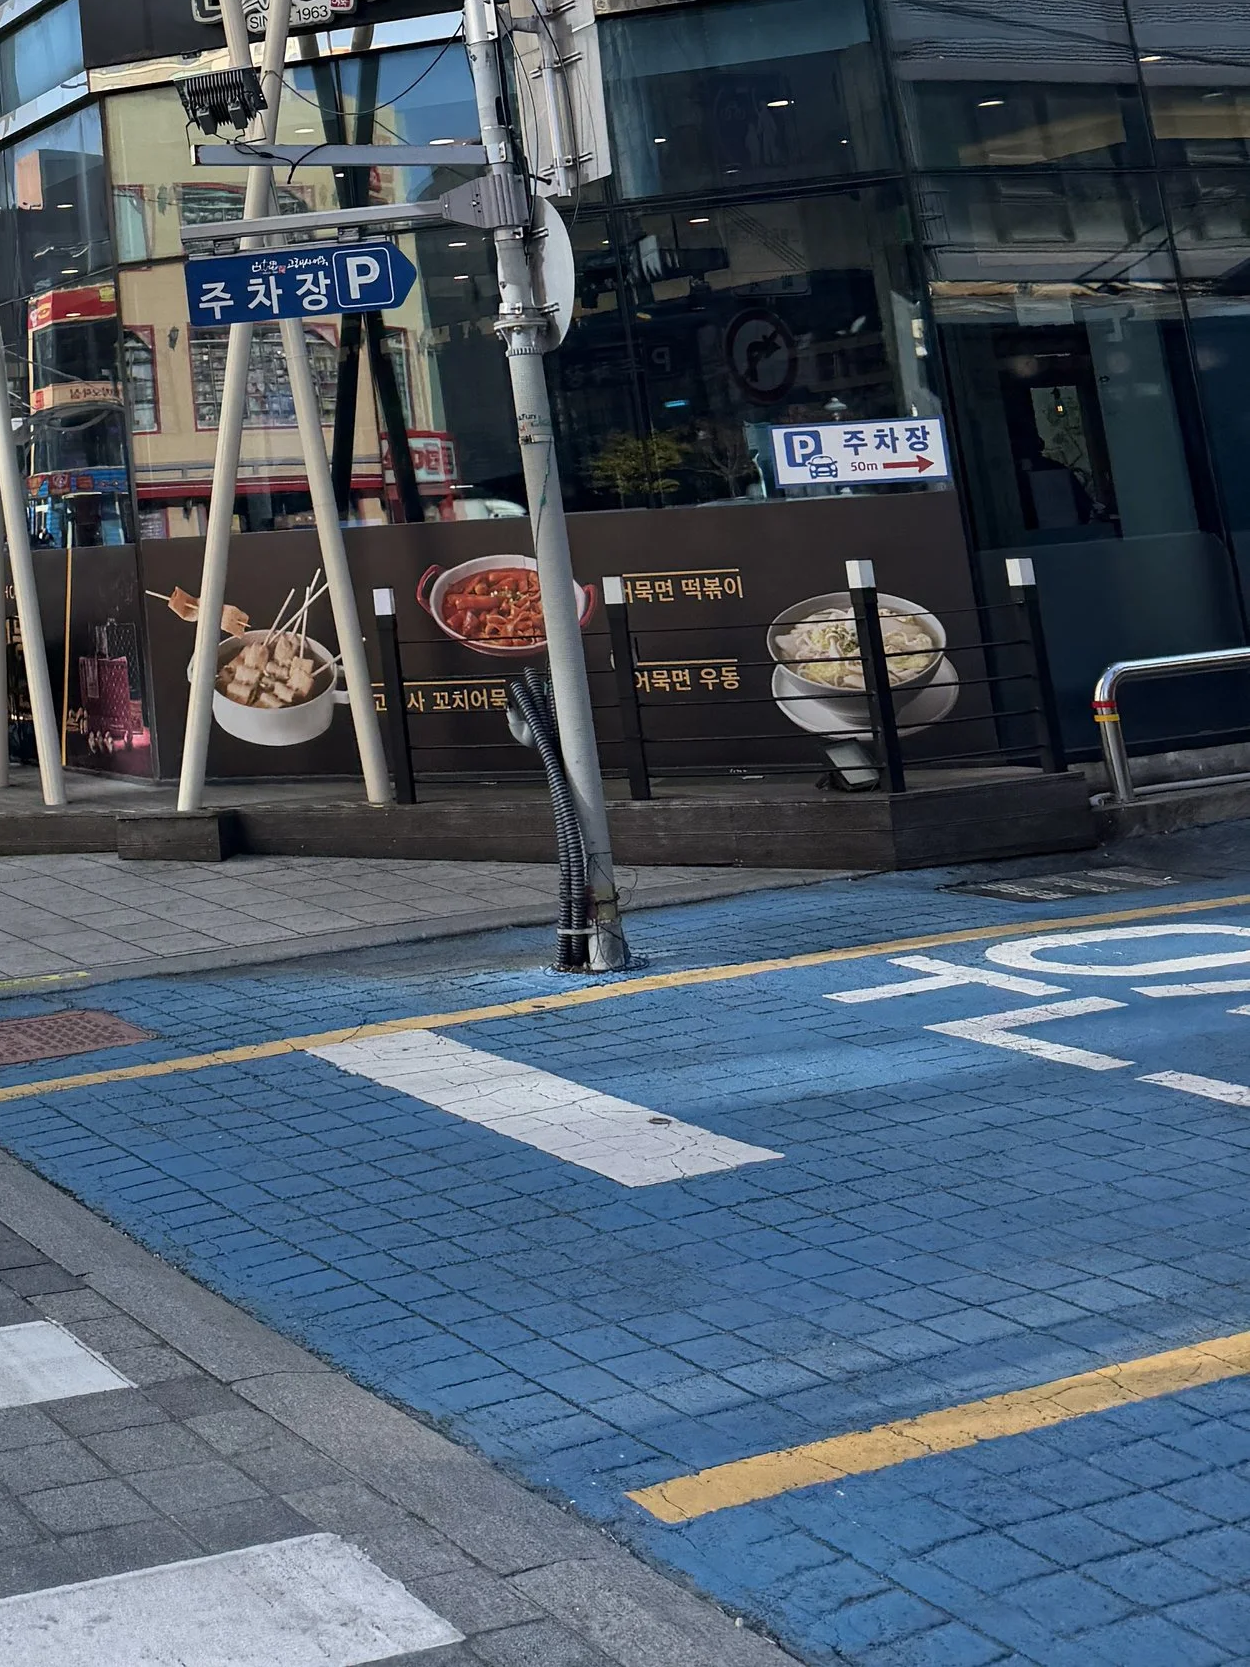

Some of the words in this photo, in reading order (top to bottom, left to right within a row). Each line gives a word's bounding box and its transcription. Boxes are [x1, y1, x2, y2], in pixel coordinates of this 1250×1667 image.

[296, 5, 328, 21] 1963
[198, 270, 332, 320] 주차장
[345, 255, 380, 300] P
[792, 435, 816, 463] P
[842, 425, 930, 456] 주차장
[850, 461, 878, 472] 50m
[681, 576, 743, 601] 떡볶이
[699, 667, 740, 691] 우동
[372, 690, 425, 713] 고사
